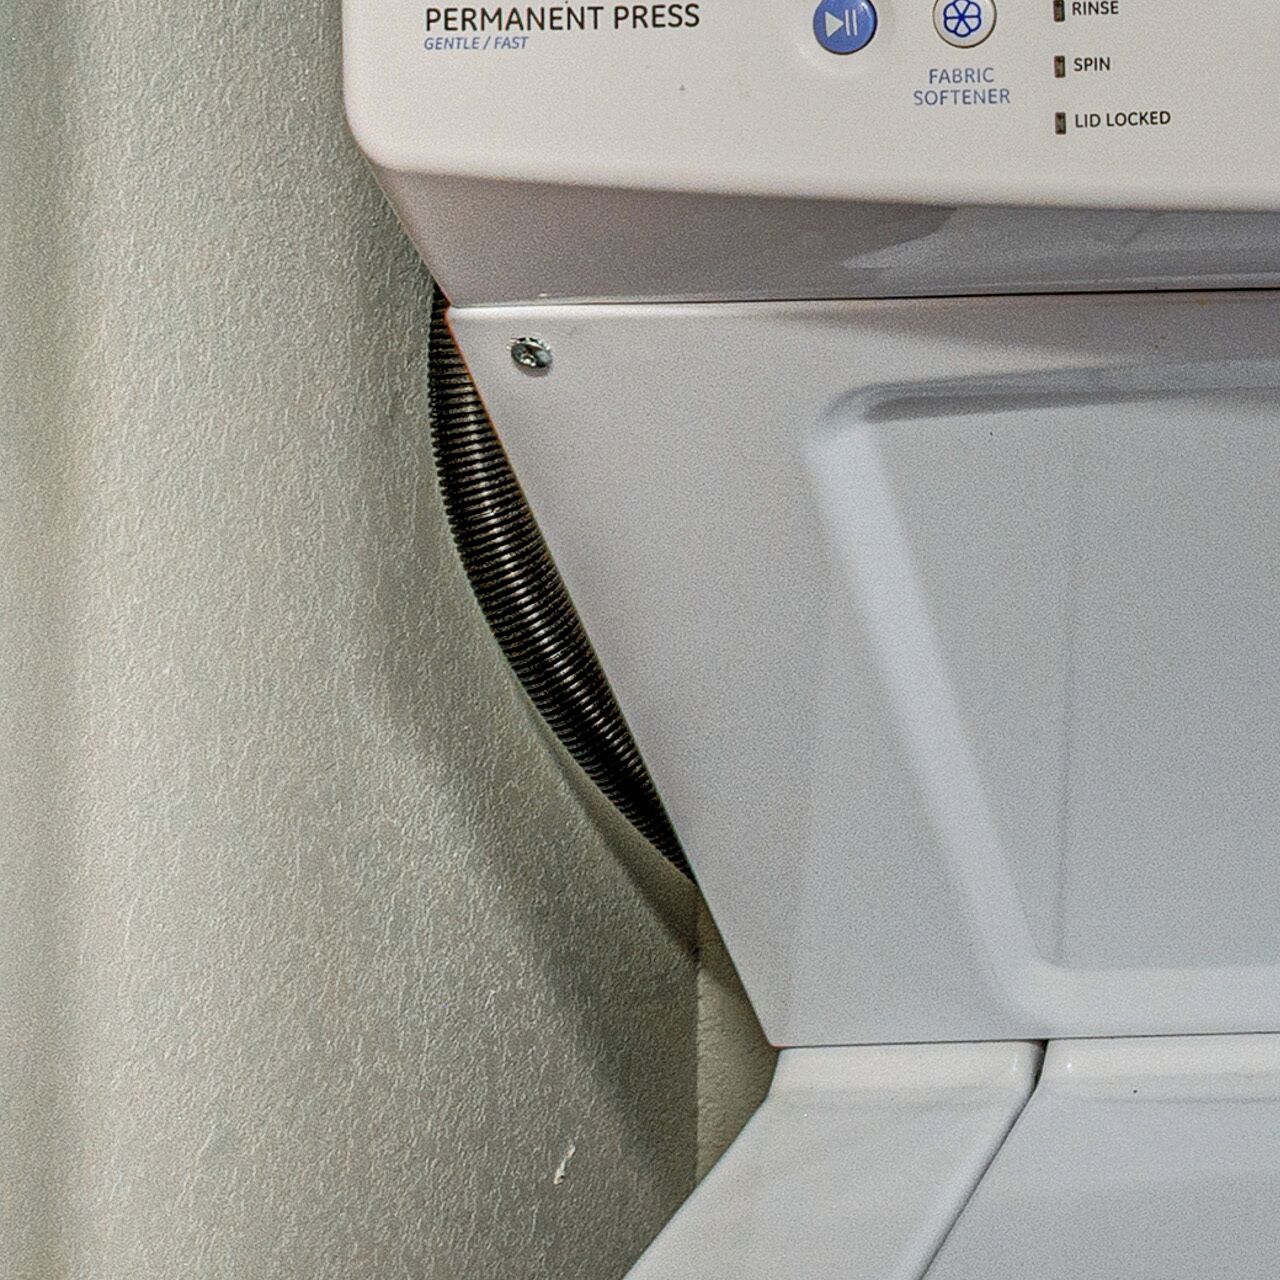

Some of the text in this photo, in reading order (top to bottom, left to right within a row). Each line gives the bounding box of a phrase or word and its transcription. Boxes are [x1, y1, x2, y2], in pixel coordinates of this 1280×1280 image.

[1072, 0, 1118, 15] RINSE
[426, 3, 700, 31] PERMANENT PRESS
[424, 37, 480, 50] GENTLE
[494, 36, 529, 49] FAST
[1074, 57, 1110, 72] SPIN
[929, 67, 994, 84] FABRIC
[914, 88, 1010, 106] SOFTENER
[1075, 111, 1171, 128] LID LOCKED
